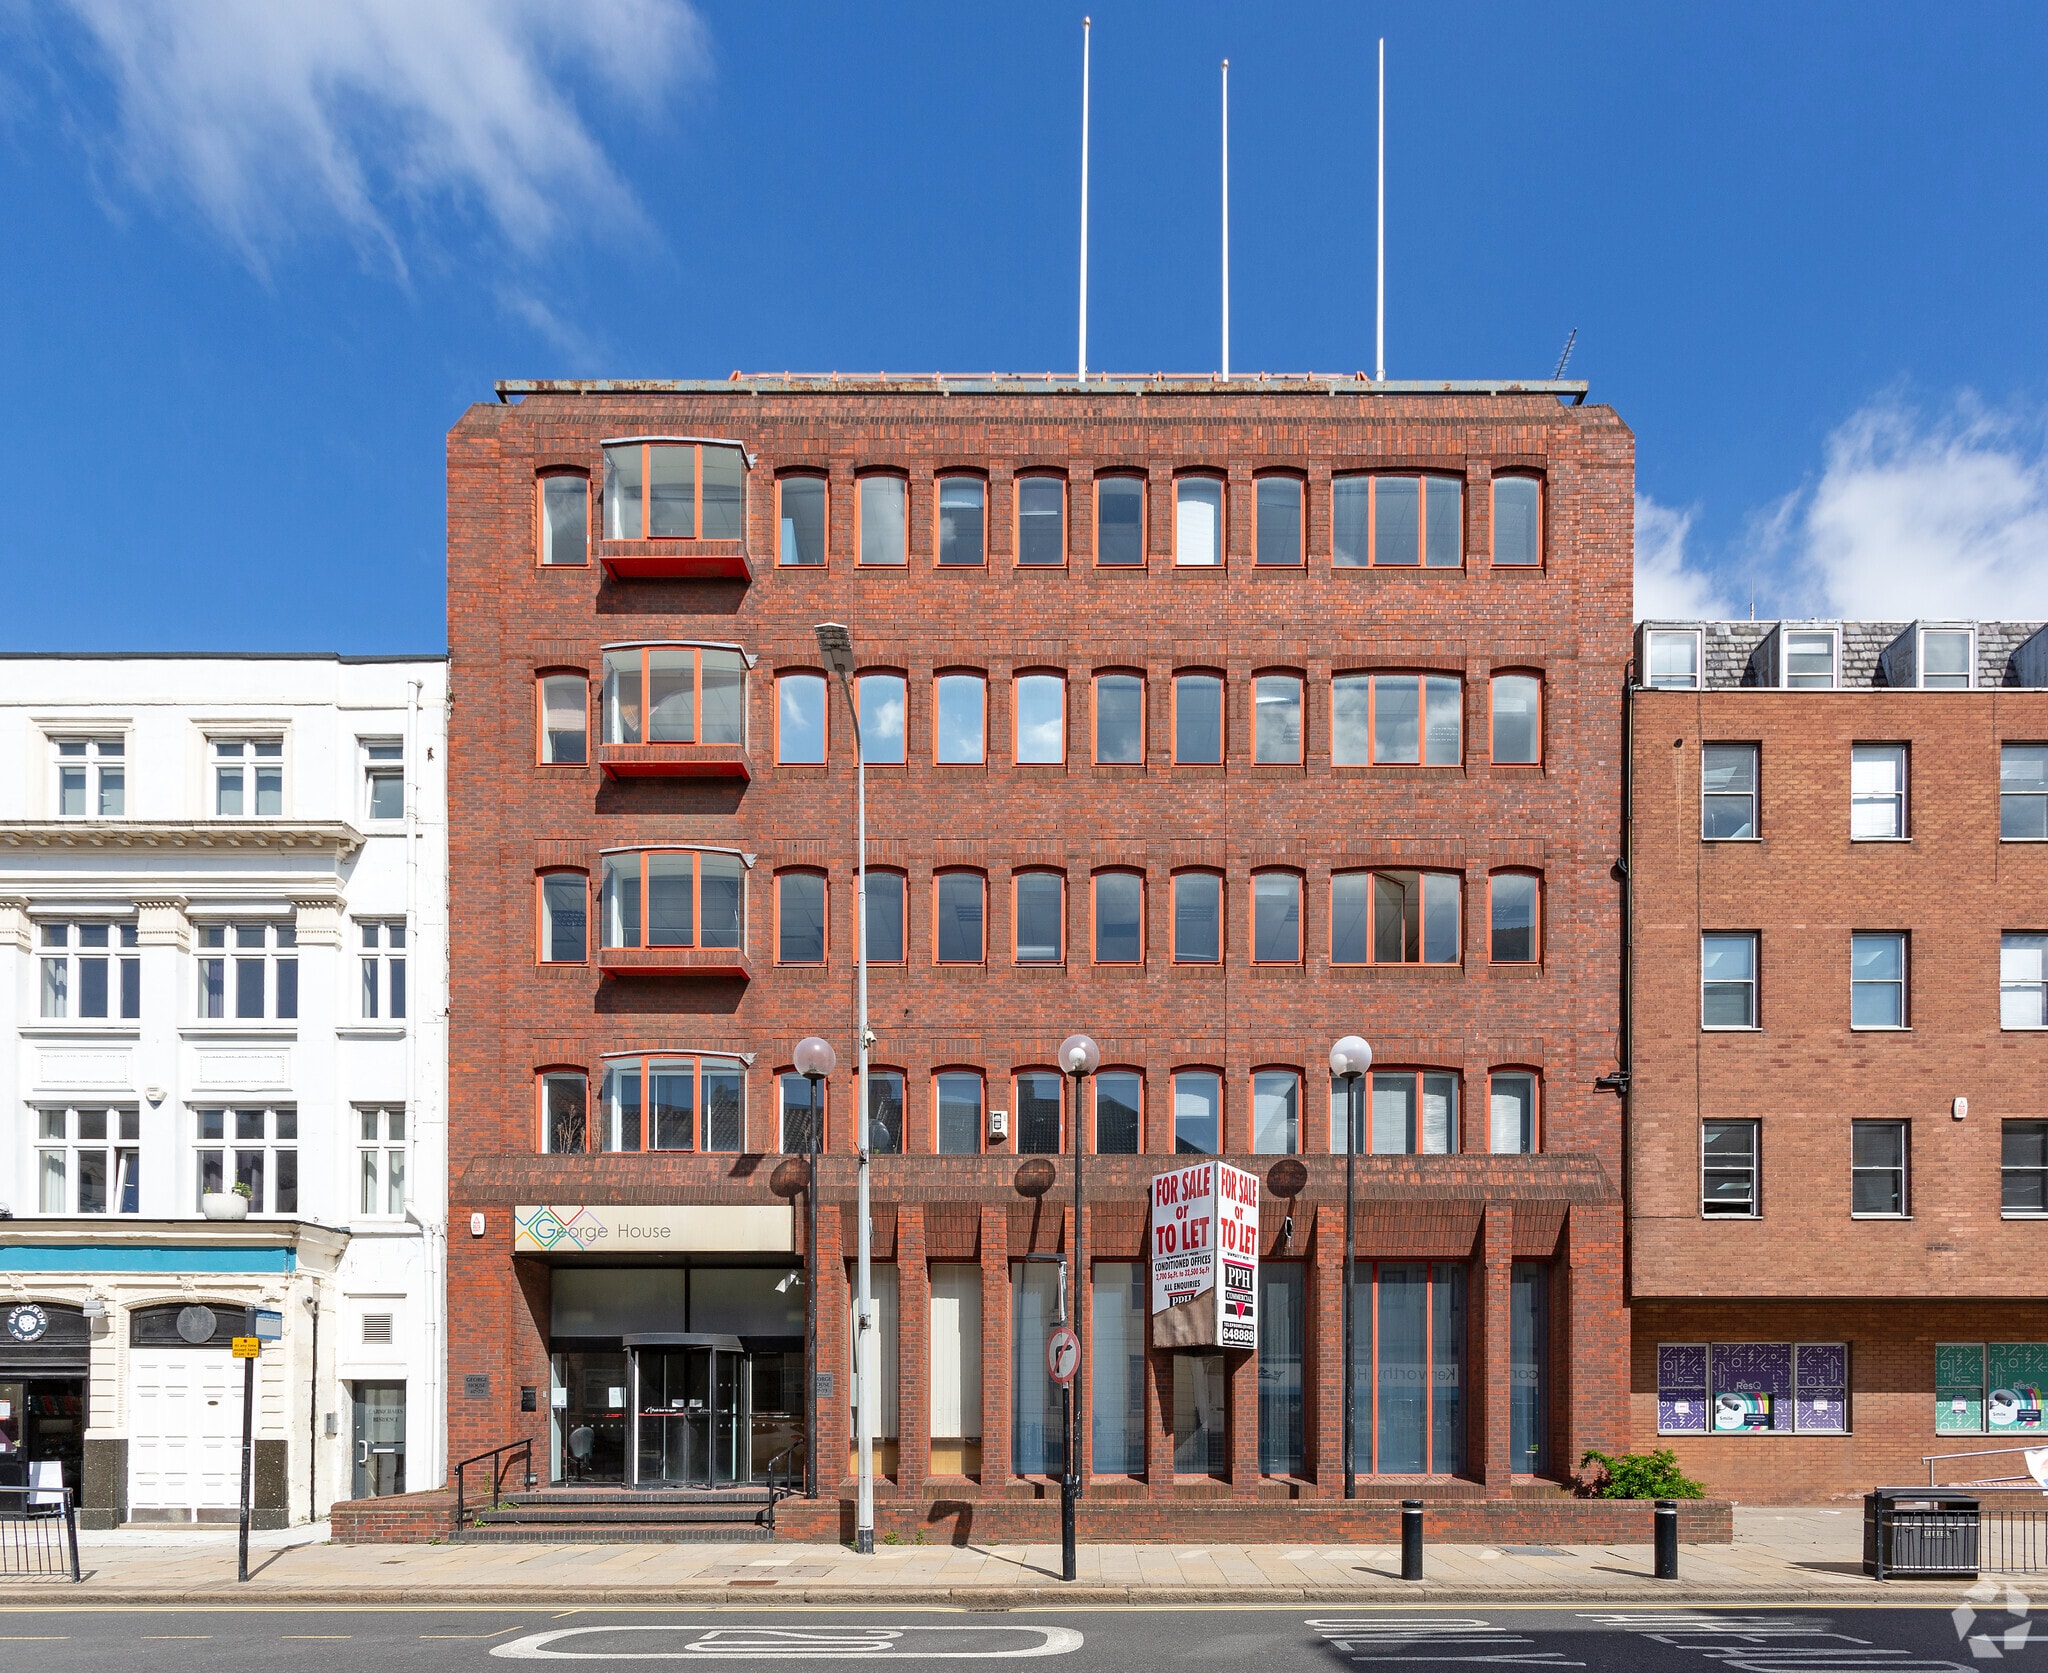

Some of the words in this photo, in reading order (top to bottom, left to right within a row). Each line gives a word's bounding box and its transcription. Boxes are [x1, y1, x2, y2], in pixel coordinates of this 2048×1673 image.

[1156, 1175, 1178, 1207] FOR
[1182, 1166, 1210, 1201] SALE
[1221, 1167, 1237, 1201] FOR
[1239, 1174, 1256, 1208] SALE
[1176, 1204, 1189, 1220] or
[1234, 1205, 1243, 1220] or
[535, 1218, 609, 1242] George
[618, 1224, 671, 1238] House
[1156, 1223, 1177, 1255] TO
[1182, 1216, 1210, 1251] LET
[1221, 1217, 1236, 1250] TO
[1239, 1223, 1256, 1256] LET
[1155, 1258, 1190, 1272] CONDITIONED
[1190, 1254, 1212, 1267] OFFICES
[1164, 1283, 1173, 1291] ALL
[1173, 1279, 1201, 1290] ENQUIRIES
[1227, 1266, 1251, 1288] PPH
[1223, 1327, 1254, 1342] 648888
[1736, 1380, 1761, 1390] ResQ
[684, 1630, 904, 1652] 20
